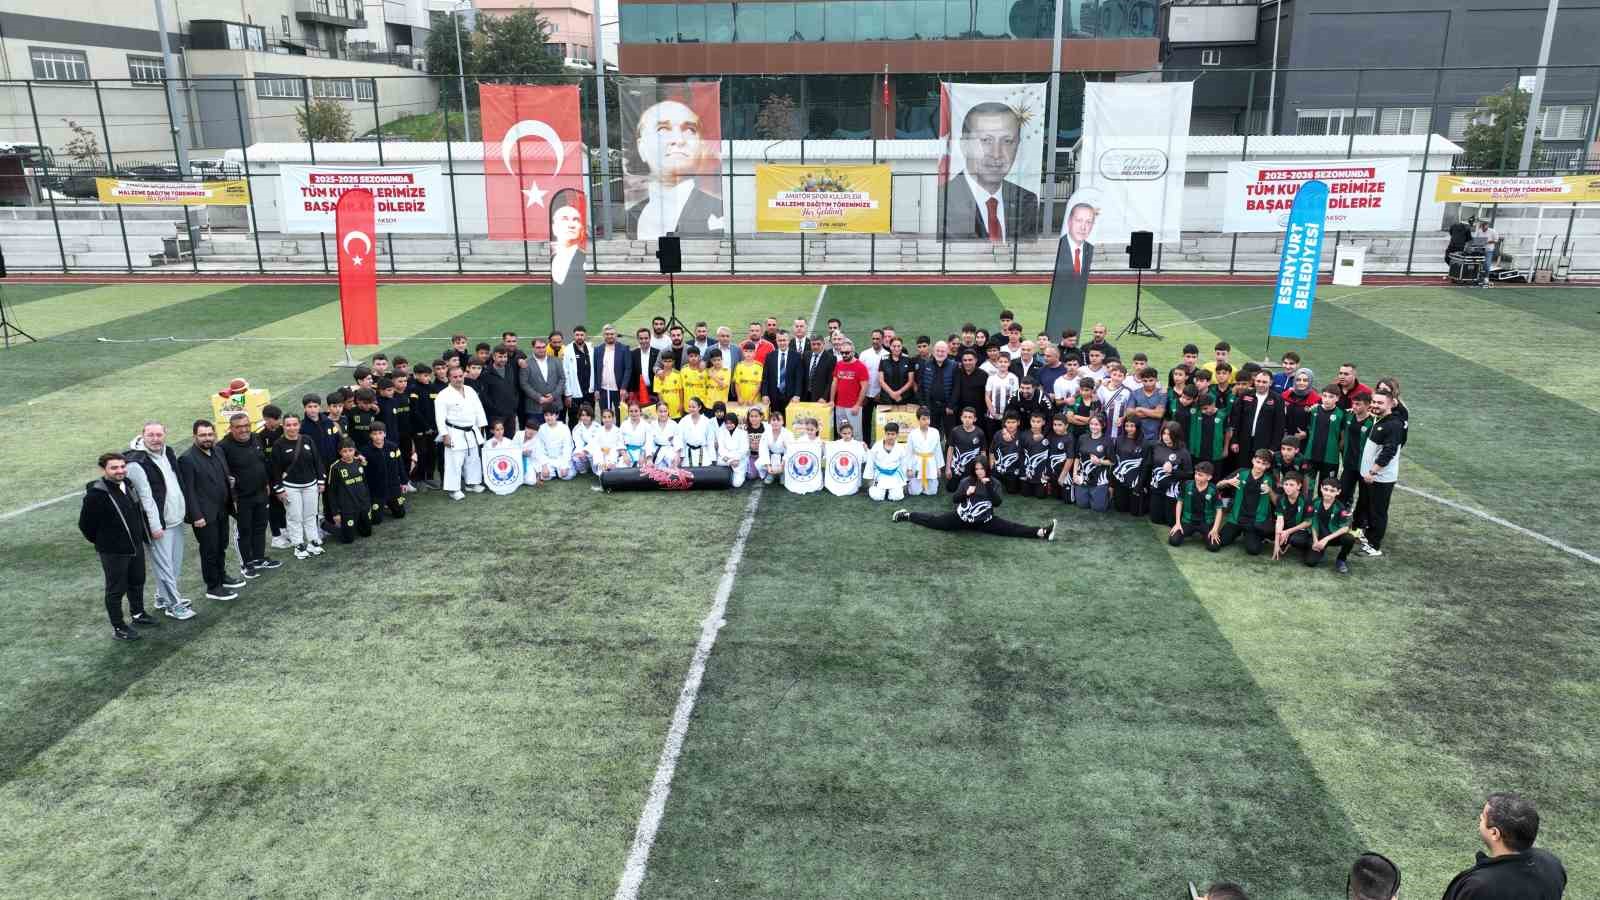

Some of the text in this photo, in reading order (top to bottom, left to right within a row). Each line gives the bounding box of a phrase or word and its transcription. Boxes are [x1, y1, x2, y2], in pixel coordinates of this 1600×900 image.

[315, 175, 409, 184] 2025-2026 SEZONUNDA
[1264, 169, 1370, 180] 2025-2026 SEZONUNDA
[301, 184, 426, 198] TÜM KULERİMİZE
[1246, 180, 1385, 196] TÜM KUERİMİZE
[378, 200, 426, 212] DİLERİZ
[1329, 195, 1382, 209] DİLERİZ
[1277, 223, 1303, 305] ESENYURT
[1294, 223, 1320, 310] BELEDİYESİ
